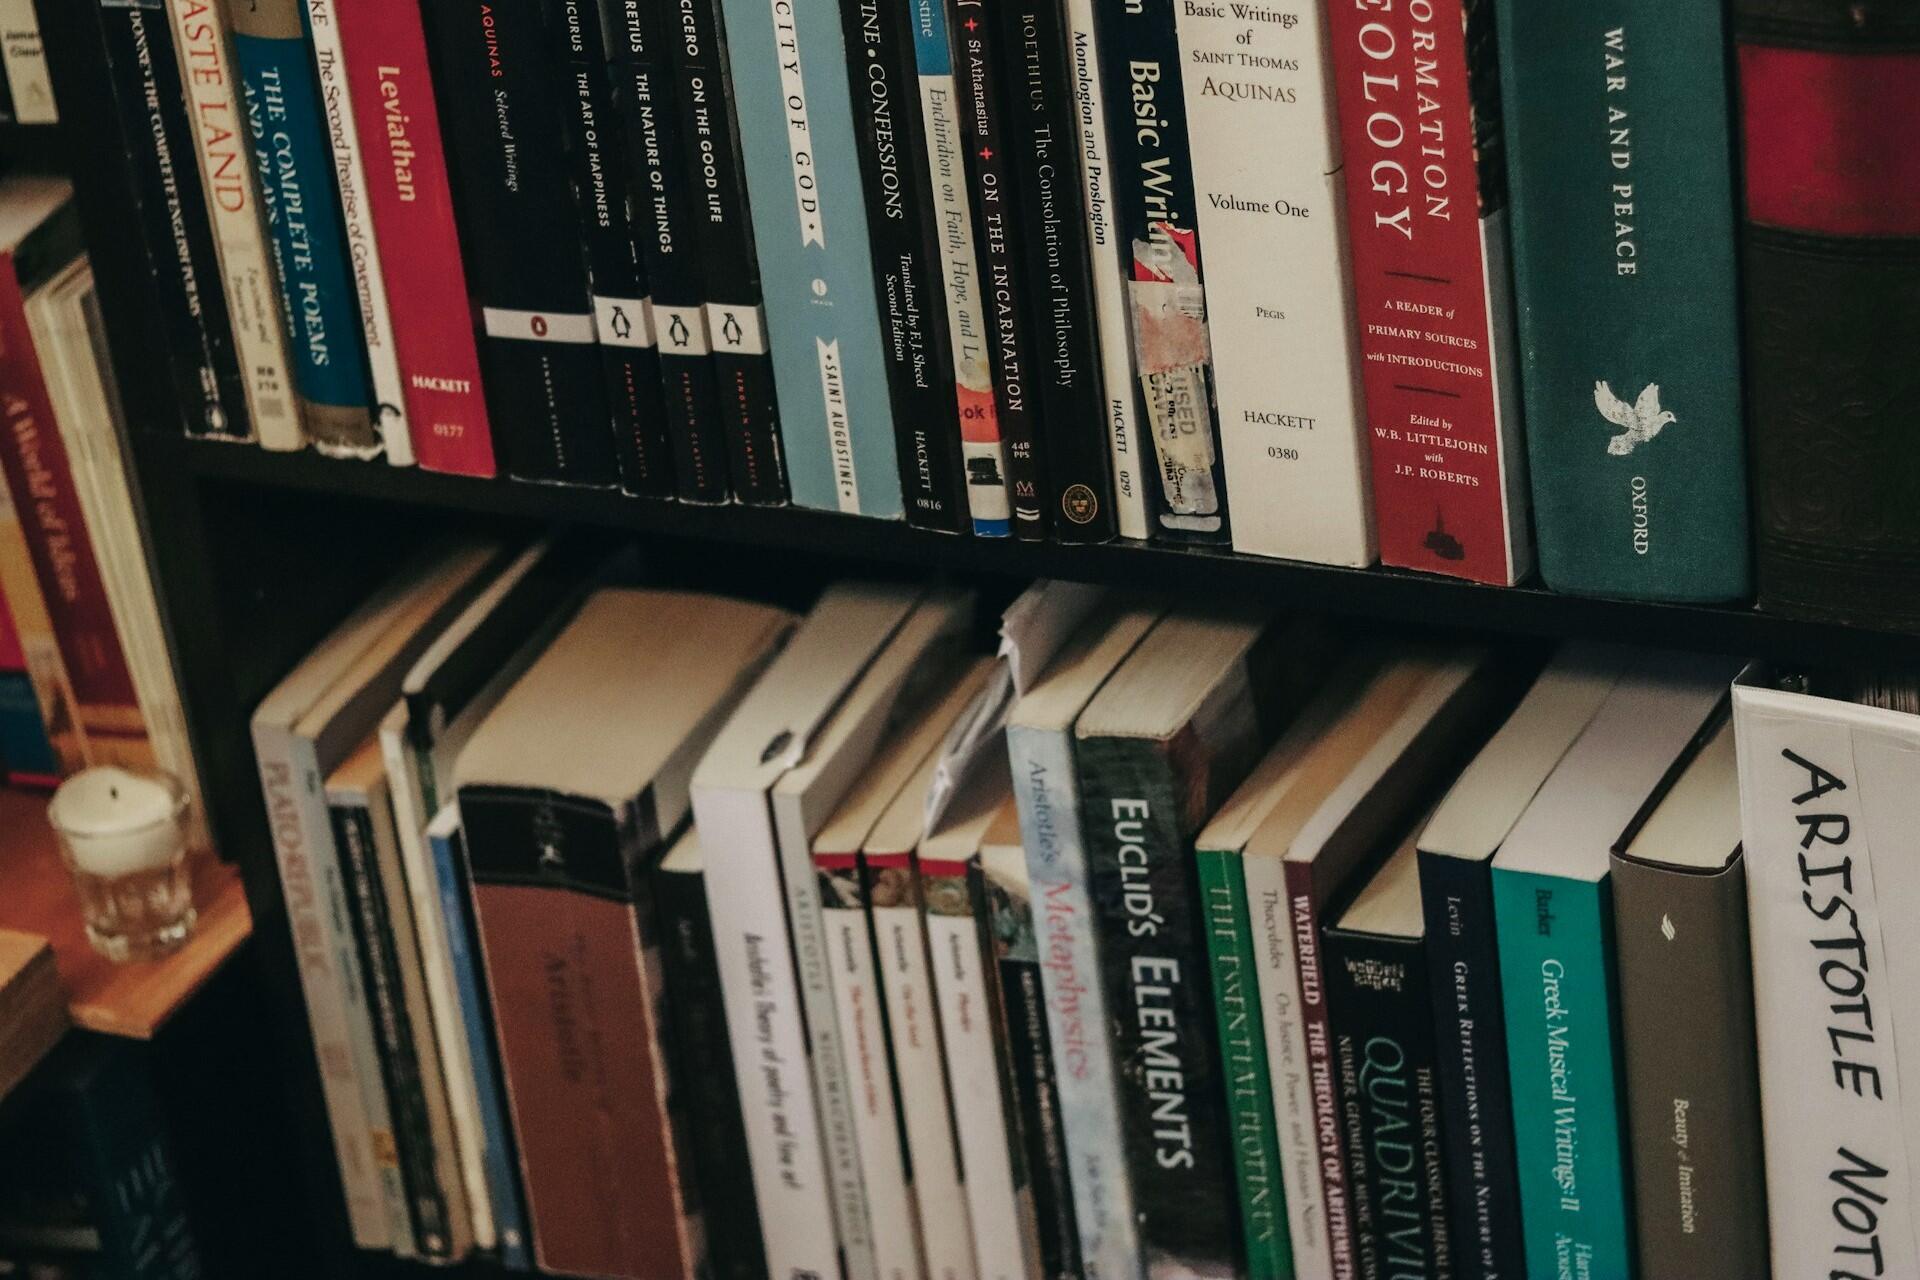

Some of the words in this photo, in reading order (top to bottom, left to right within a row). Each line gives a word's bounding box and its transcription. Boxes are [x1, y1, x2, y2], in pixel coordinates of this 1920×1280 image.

[480, 4, 503, 78] AQUINAS
[565, 1, 583, 53] ICURUS
[624, 0, 643, 54] RETIUS
[680, 0, 700, 58] CICERO
[775, 0, 800, 75] CITY
[1184, 1, 1226, 19] Basic
[1228, 2, 1300, 30] Writings
[1235, 29, 1254, 46] of
[318, 48, 340, 82] The
[967, 39, 982, 56] St
[1021, 13, 1045, 113] BOETHIUS
[1191, 49, 1235, 66] SAINT
[1237, 52, 1300, 72] THOMAS
[1603, 26, 1628, 94] WAR
[261, 66, 287, 122] THE
[576, 71, 591, 98] THE
[635, 72, 651, 102] THE
[690, 77, 706, 104] ON
[969, 57, 990, 137] Athanasius
[1073, 30, 1096, 127] Monologion
[1200, 76, 1298, 105] AQUINAS
[323, 82, 351, 151] Second
[494, 89, 515, 140] Selected
[581, 100, 595, 127] ART
[695, 107, 711, 137] THE
[786, 94, 808, 132] OF
[1129, 60, 1170, 149] Basic
[1408, 0, 1451, 222] ORMATION
[199, 102, 245, 213] LAND
[242, 78, 265, 140] AND
[256, 149, 281, 226] PLAYS
[377, 64, 416, 202] Leviathan
[585, 129, 598, 150] OF
[640, 105, 661, 167] NATURE
[867, 62, 905, 222] CONFESSIONS
[929, 87, 952, 179] Enchiridion
[1034, 123, 1053, 159] The
[1083, 129, 1101, 162] and
[1607, 105, 1631, 171] AND
[336, 149, 359, 219] Treatise
[503, 141, 520, 193] Writings
[588, 151, 611, 228] HAPPINESS
[650, 170, 664, 194] OF
[700, 139, 718, 190] GOOD
[794, 151, 818, 215] GOD
[982, 173, 1000, 203] ON
[272, 131, 315, 273] COMPLETE
[707, 193, 723, 224] LIFE
[941, 183, 956, 203] on
[1038, 163, 1062, 271] Consolation
[1087, 164, 1108, 246] Proslogion
[1206, 192, 1270, 215] Volume
[1274, 199, 1311, 218] One
[348, 219, 363, 241] of
[653, 195, 673, 254] THINGS
[945, 209, 967, 255] Faith,
[987, 213, 1005, 254] THE
[1611, 182, 1638, 277] PEACE
[352, 242, 382, 349] Government
[885, 273, 900, 316] Second
[899, 252, 919, 314] Translated
[952, 259, 970, 306] Hope,
[1050, 272, 1069, 294] of
[299, 281, 329, 367] POEMS
[907, 314, 921, 330] by
[957, 309, 979, 339] and
[1255, 306, 1287, 321] PEGIS
[1383, 299, 1394, 310] A
[1395, 300, 1444, 318] READER
[1445, 308, 1456, 321] of
[891, 318, 905, 362] Edition
[993, 264, 1023, 412] INCARNATION
[1053, 296, 1078, 388] Philosophy
[1367, 323, 1422, 342] PRIMARY
[1424, 331, 1478, 351] SOURCES
[412, 375, 471, 394] HACKETT
[823, 363, 842, 406] SAINT
[912, 353, 929, 389] Sheed
[1366, 351, 1386, 364] with
[1386, 352, 1484, 379] INTRODUCTIONS
[1111, 398, 1128, 455] HACKETT
[1243, 409, 1317, 432] HACKETT
[1374, 426, 1402, 442] W.B.
[1405, 430, 1489, 456] LITTLEJOHN
[1409, 413, 1441, 429] Edited
[1441, 419, 1454, 432] by
[831, 410, 855, 488] AUGUSTINE
[914, 429, 932, 493] HACKETT
[1013, 450, 1031, 459] PPS
[1266, 445, 1300, 462] 0380
[1424, 451, 1445, 465] with
[1119, 469, 1132, 499] 0297
[1393, 463, 1416, 478] J.P.
[1418, 466, 1480, 488] ROBERTS
[916, 498, 943, 511] 0816
[1630, 476, 1650, 556] OXFORD
[1027, 758, 1061, 865] Aristotle's
[1110, 797, 1165, 938] EUCLID'S
[1209, 886, 1238, 942] THE
[1446, 895, 1461, 937] Levin
[1534, 886, 1553, 938] Barker
[1780, 746, 1884, 1102] ARISTOTLE
[1262, 889, 1284, 970] Thucydides
[1275, 991, 1291, 1017] On
[1293, 895, 1322, 1006] WATERFIELD
[1040, 879, 1089, 1082] Metaphysics
[1453, 961, 1470, 1014] GREEK
[1540, 958, 1569, 1027] Greek
[1130, 954, 1196, 1170] ELEMENTS
[1307, 1020, 1326, 1061] THE
[1545, 1024, 1576, 1102] Musical
[1417, 1067, 1432, 1096] THE
[1458, 1018, 1482, 1122] REFLECTIONS
[1311, 1062, 1339, 1155] THEOLOGY
[1420, 1098, 1438, 1138] FOUR
[1672, 1097, 1690, 1149] Beauty
[1469, 1124, 1483, 1146] ON
[1322, 1156, 1342, 1185] OF
[1472, 1150, 1487, 1182] THE
[1475, 1184, 1492, 1244] NATURE
[1677, 1163, 1695, 1235] Imitation
[1480, 1247, 1495, 1267] OF
